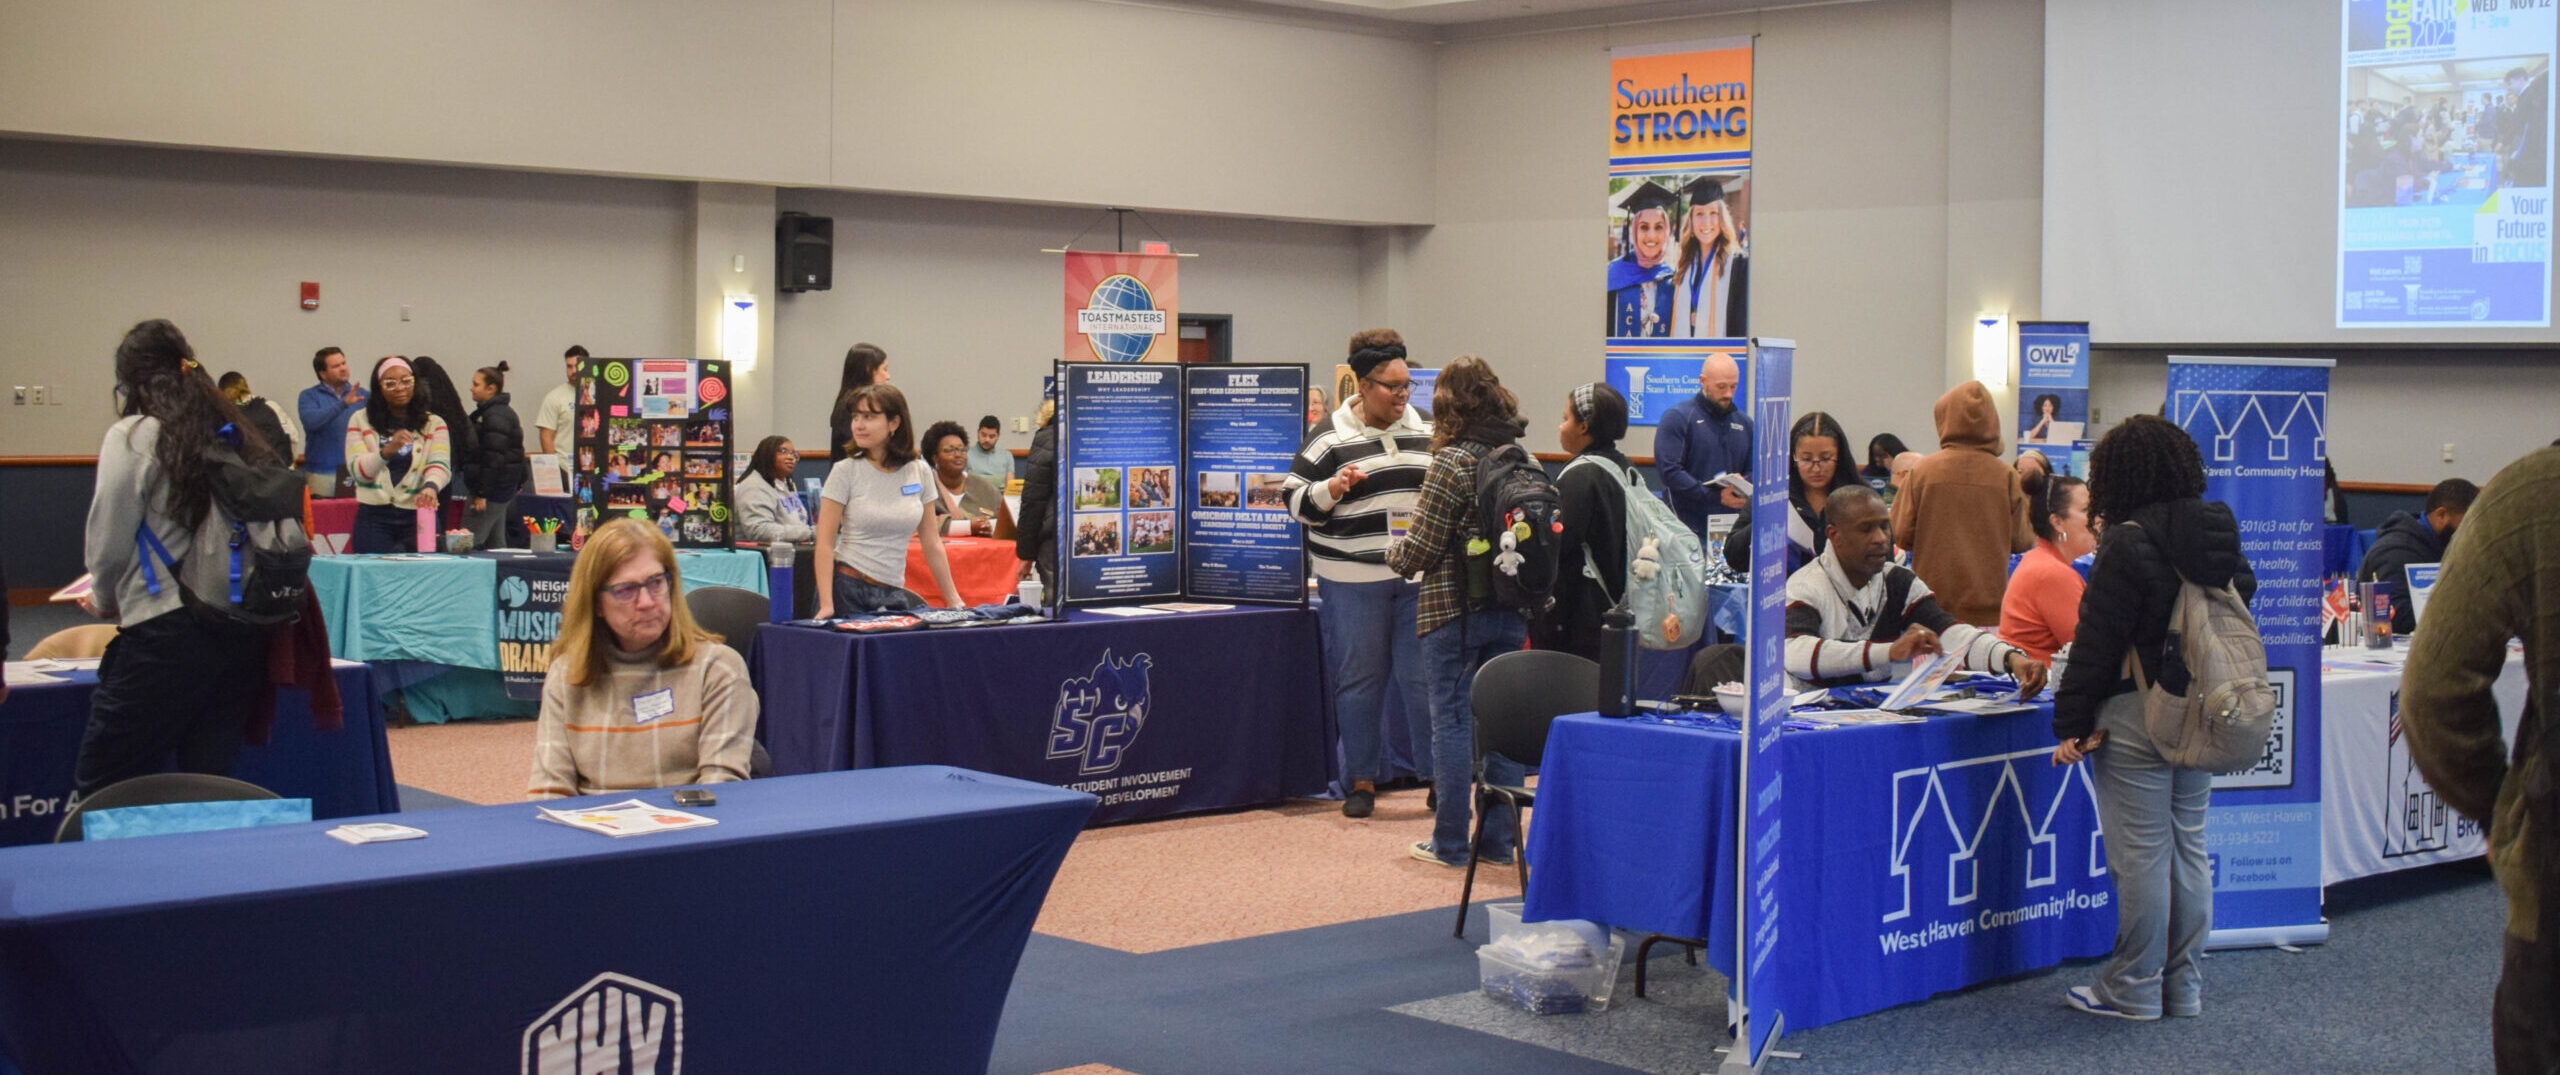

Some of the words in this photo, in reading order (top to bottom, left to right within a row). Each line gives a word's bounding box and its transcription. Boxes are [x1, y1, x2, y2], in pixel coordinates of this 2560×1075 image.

[2471, 0, 2498, 13] WED
[2414, 21, 2457, 48] 2025
[1616, 73, 1746, 110] Southern
[1614, 106, 1747, 143] STRONG
[2511, 195, 2547, 215] Your
[2497, 218, 2546, 239] Future
[2475, 242, 2488, 263] in
[2494, 242, 2546, 261] FOCUS
[1081, 312, 1163, 323] TOASTMASTERS
[1089, 323, 1154, 331] INTERNATIONAL
[1087, 371, 1163, 384] LEADERSHIP
[1228, 374, 1260, 387] FLEX
[1646, 374, 1680, 384] Southern
[1646, 385, 1664, 393] State
[2235, 465, 2298, 479] Community
[2300, 466, 2325, 477] Hous
[1191, 510, 1234, 521] OMICRON
[1234, 511, 1263, 522] DELTA
[2240, 520, 2277, 533] 501(c)3
[2279, 521, 2297, 532] not
[2299, 519, 2313, 535] for
[2240, 539, 2270, 551] zation
[2273, 538, 2293, 550] that
[2297, 539, 2322, 550] exists
[2258, 558, 2299, 572] healthy,
[532, 580, 569, 591] NEIGH
[2257, 577, 2299, 591] pendent
[2302, 577, 2320, 588] and
[532, 593, 568, 603] MUSIC
[2259, 597, 2273, 610] for
[2277, 596, 2320, 608] children,
[499, 610, 562, 641] MUSIC
[2258, 615, 2300, 629] families,
[2303, 616, 2321, 626] and
[2261, 633, 2316, 645] disabilities.
[499, 641, 550, 673] DRAM
[1047, 697, 1127, 776] SC
[1070, 777, 1119, 793] STUDENT
[1121, 768, 1192, 787] INVOLVEMENT
[1105, 785, 1180, 806] DEVELOPMENT
[14, 795, 60, 818] For
[2241, 810, 2271, 824] West
[2273, 809, 2312, 823] Haven
[2230, 856, 2264, 867] Follow
[2266, 857, 2277, 866] us
[2279, 856, 2292, 865] on
[2230, 871, 2277, 883] Facebook
[1879, 928, 1927, 956] West
[1928, 917, 1975, 944] Haven
[1979, 895, 2066, 931] Community
[2065, 888, 2109, 910] House
